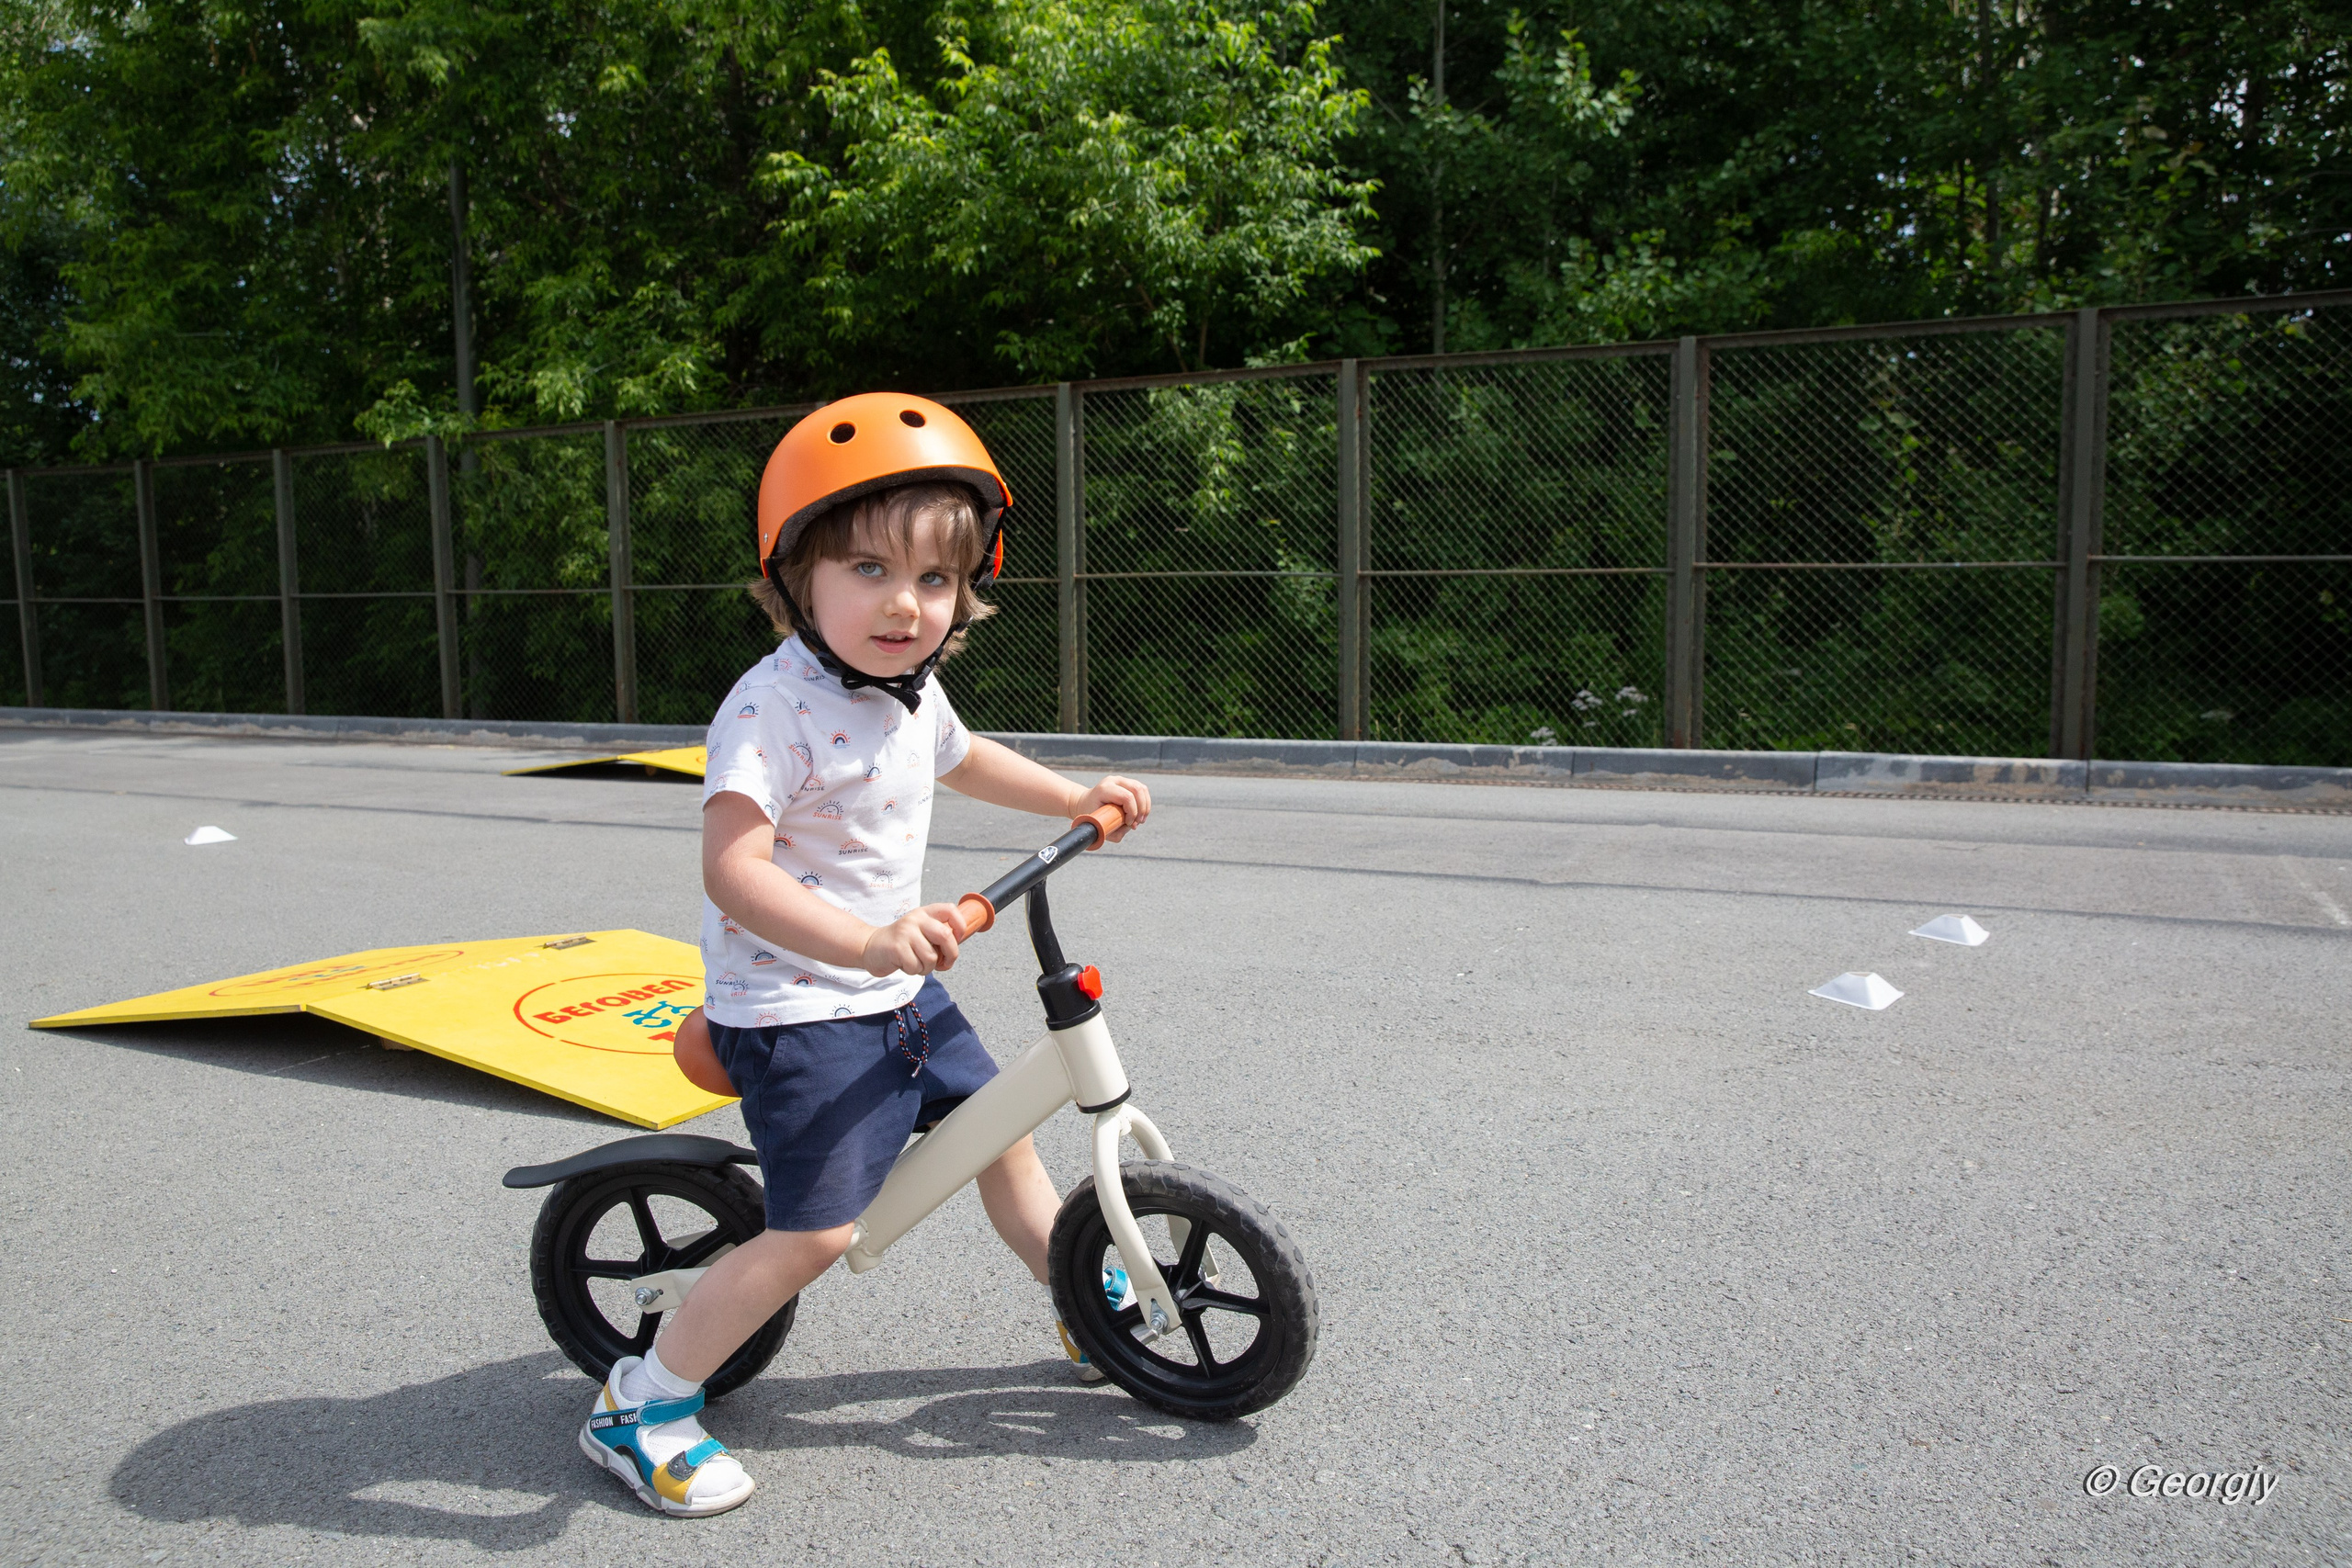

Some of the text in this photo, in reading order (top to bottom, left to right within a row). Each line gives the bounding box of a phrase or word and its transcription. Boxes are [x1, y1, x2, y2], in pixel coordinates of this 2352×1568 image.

[788, 744, 812, 768] SUNRISE
[813, 811, 842, 820] SUNRISE
[532, 979, 696, 1024] БЕГОВЕЛ
[591, 1413, 638, 1430] FASHION FASH
